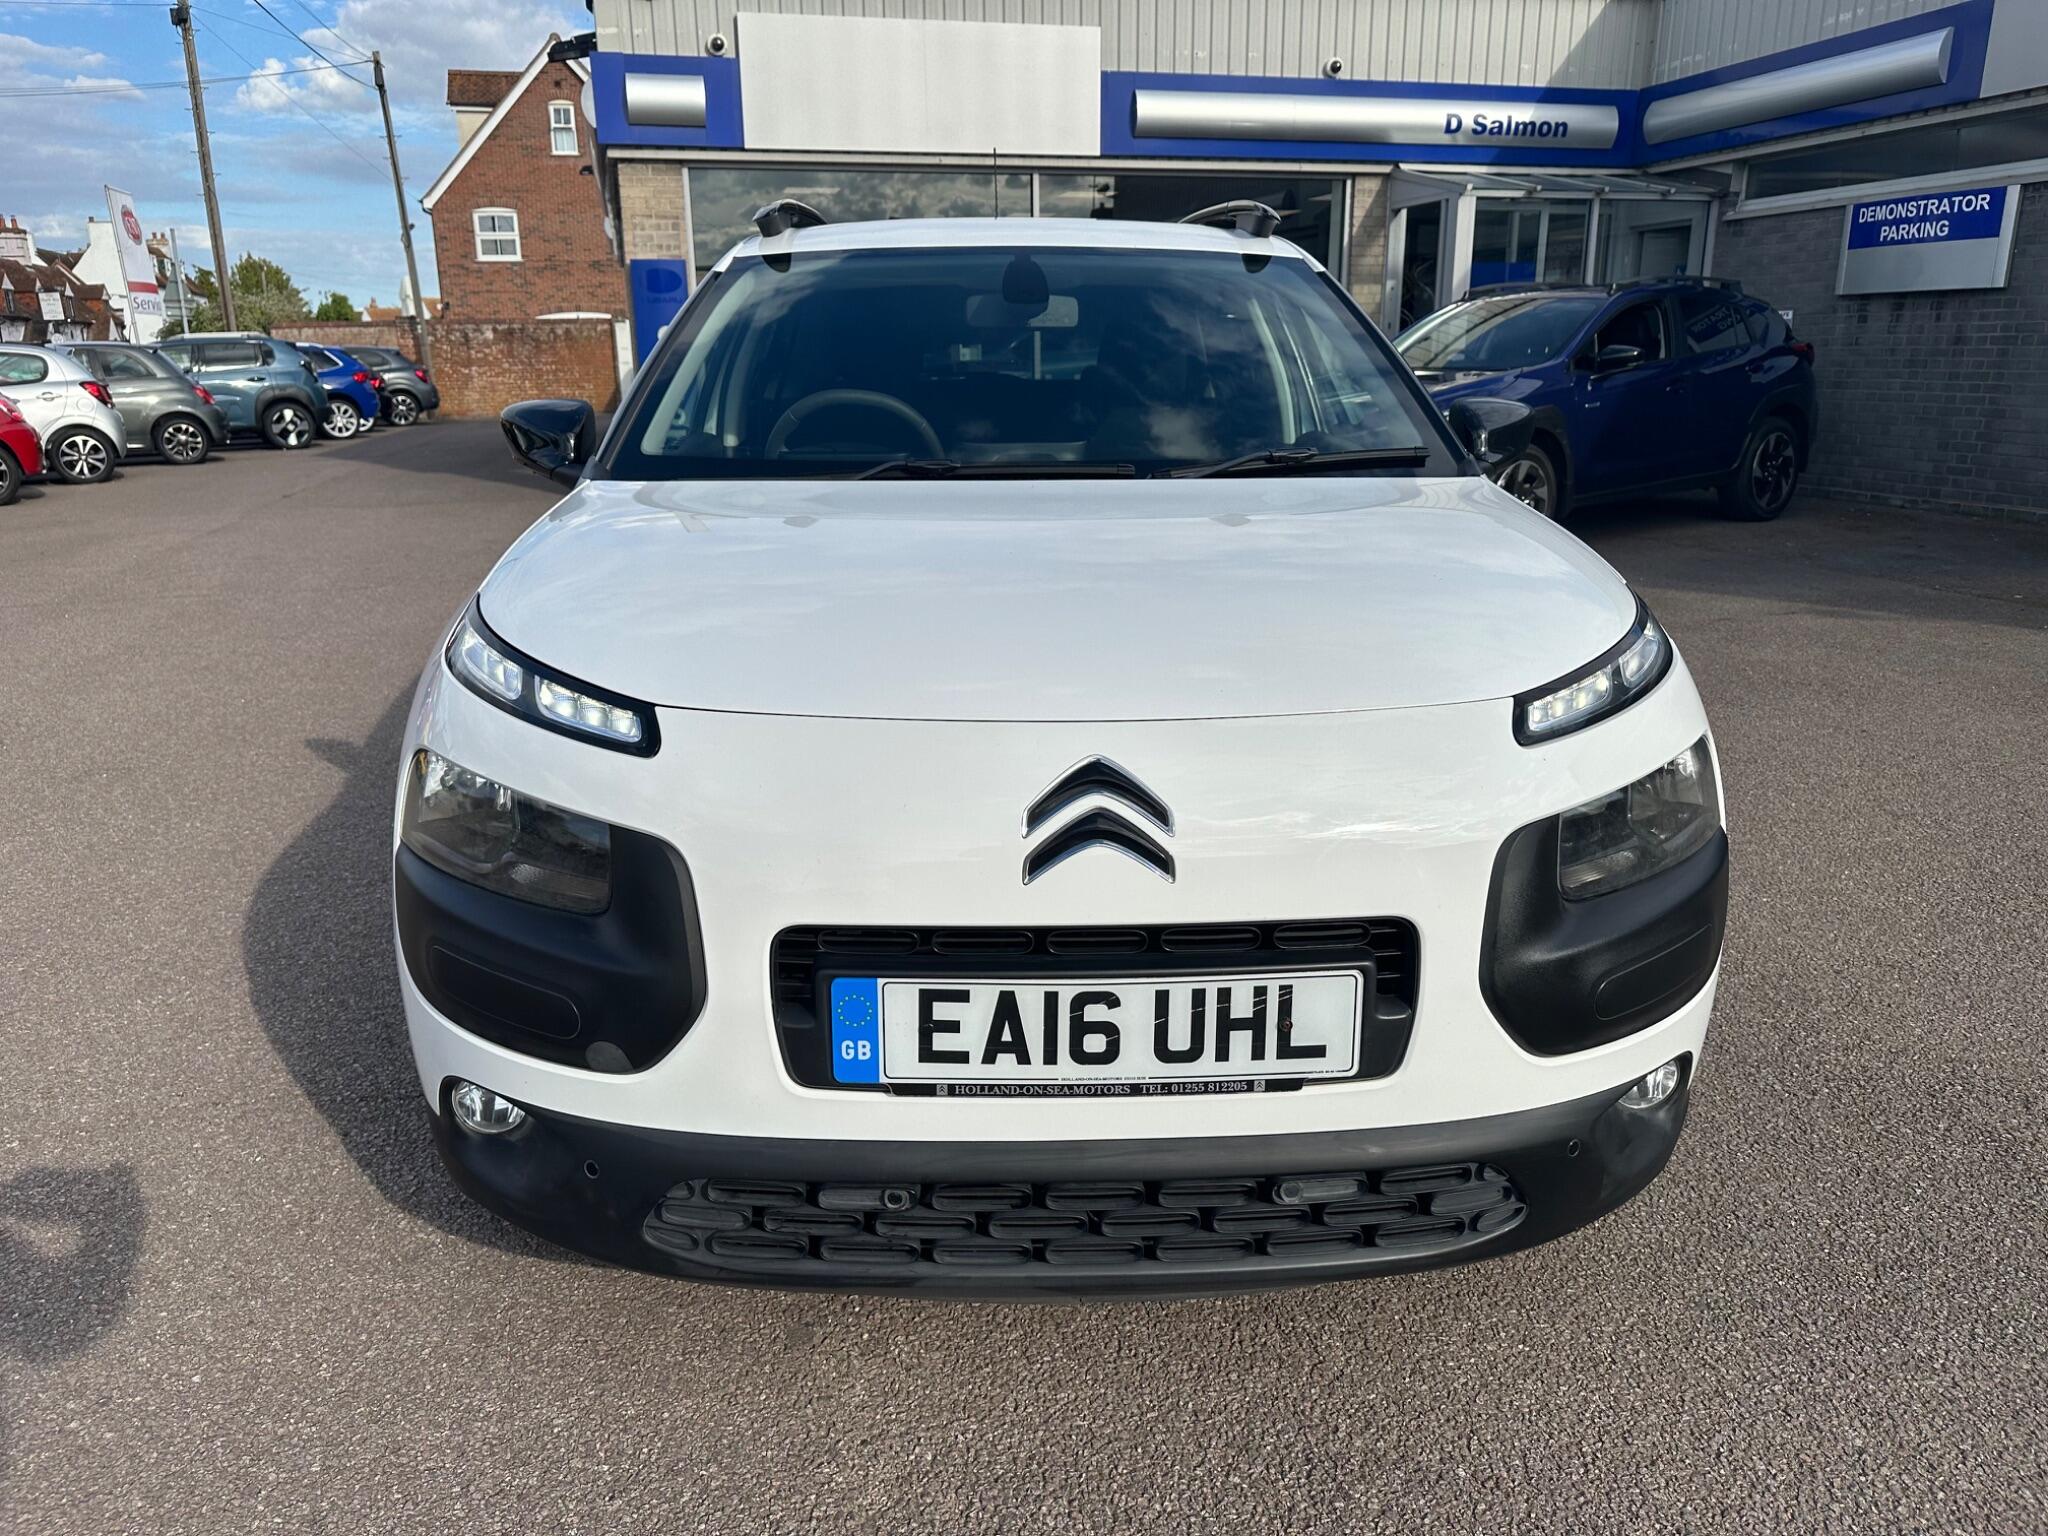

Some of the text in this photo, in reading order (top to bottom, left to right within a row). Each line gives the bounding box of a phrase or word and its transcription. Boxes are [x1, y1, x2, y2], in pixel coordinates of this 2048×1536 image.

[1444, 113, 1569, 138] D Salmon
[1858, 193, 1991, 224] DEMONSTRATOR
[1879, 220, 1950, 242] PARKING
[918, 984, 1327, 1066] EA16 UHL
[841, 1039, 872, 1060] GB
[955, 1081, 1248, 1095] HOLLAND-ON-SEA-MOTORS TEL: 01255 812205
